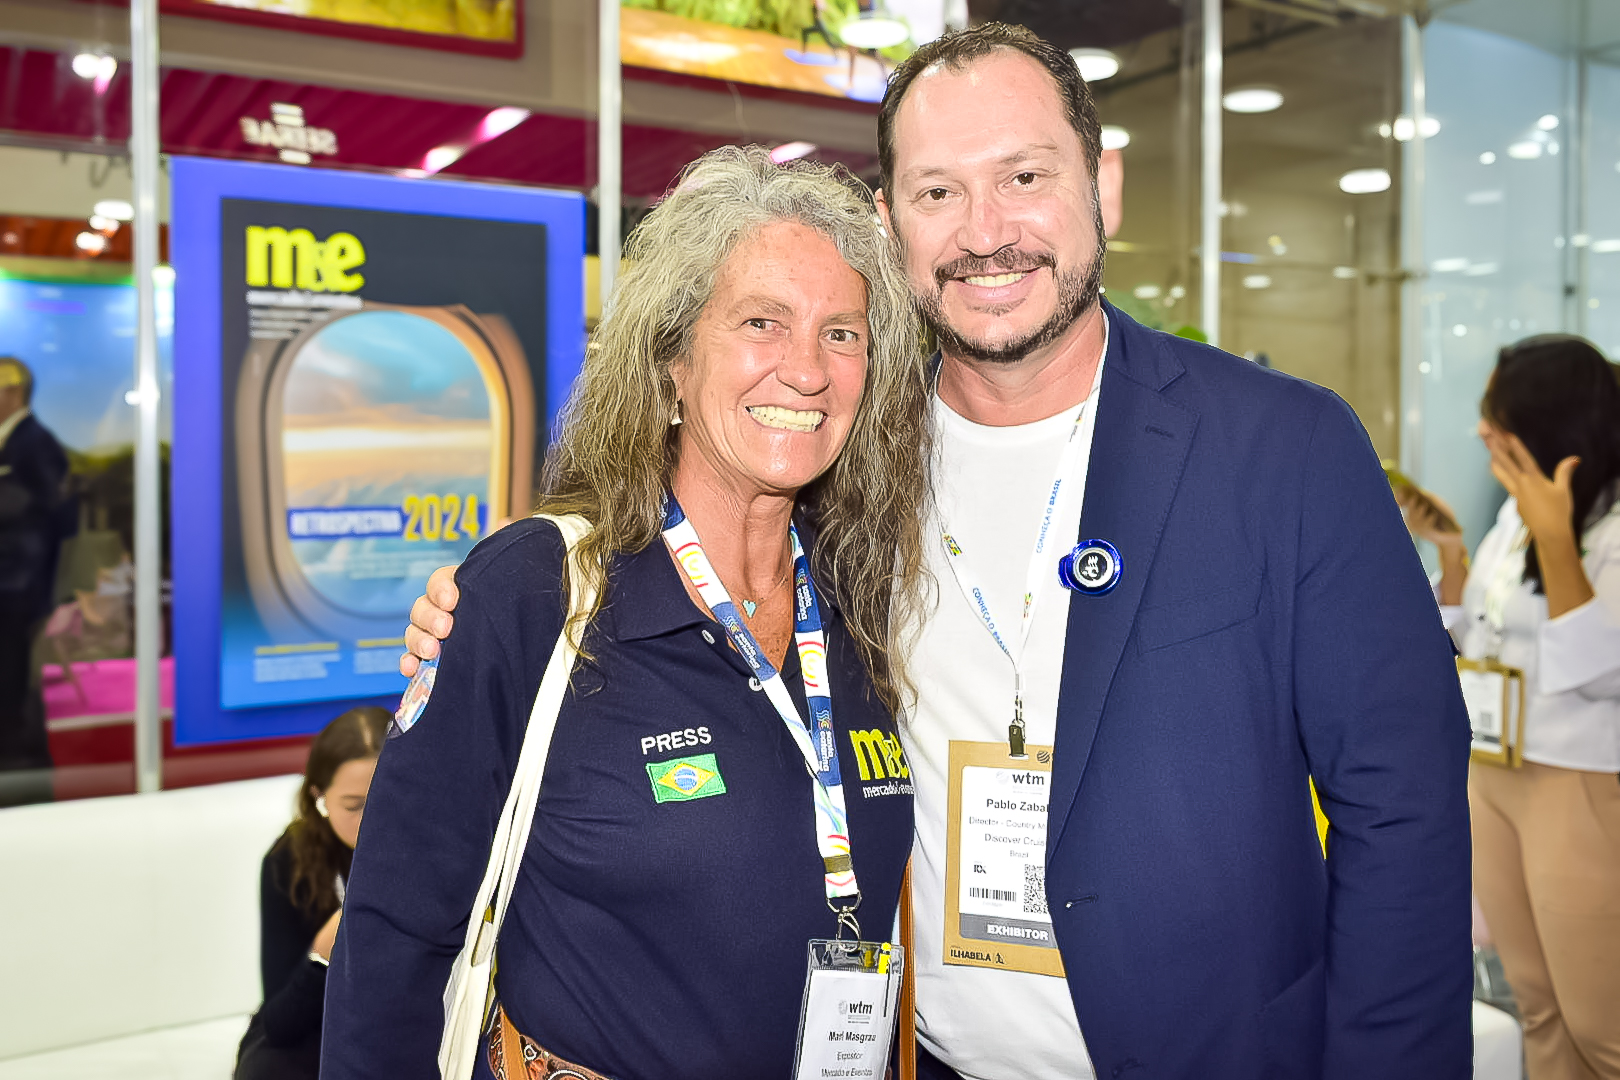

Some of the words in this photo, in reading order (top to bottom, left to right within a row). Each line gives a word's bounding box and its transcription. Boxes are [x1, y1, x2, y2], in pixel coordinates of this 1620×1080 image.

[403, 493, 480, 542] 2024
[640, 726, 712, 755] PRESS
[1012, 771, 1045, 786] wtm
[986, 798, 1017, 811] Pablo
[968, 815, 999, 826] Director
[1005, 819, 1036, 830] Country
[984, 833, 1021, 844] Discover
[986, 924, 1049, 941] EXHIBITOR
[950, 948, 992, 962] ILHABELA
[849, 1000, 873, 1015] wtm
